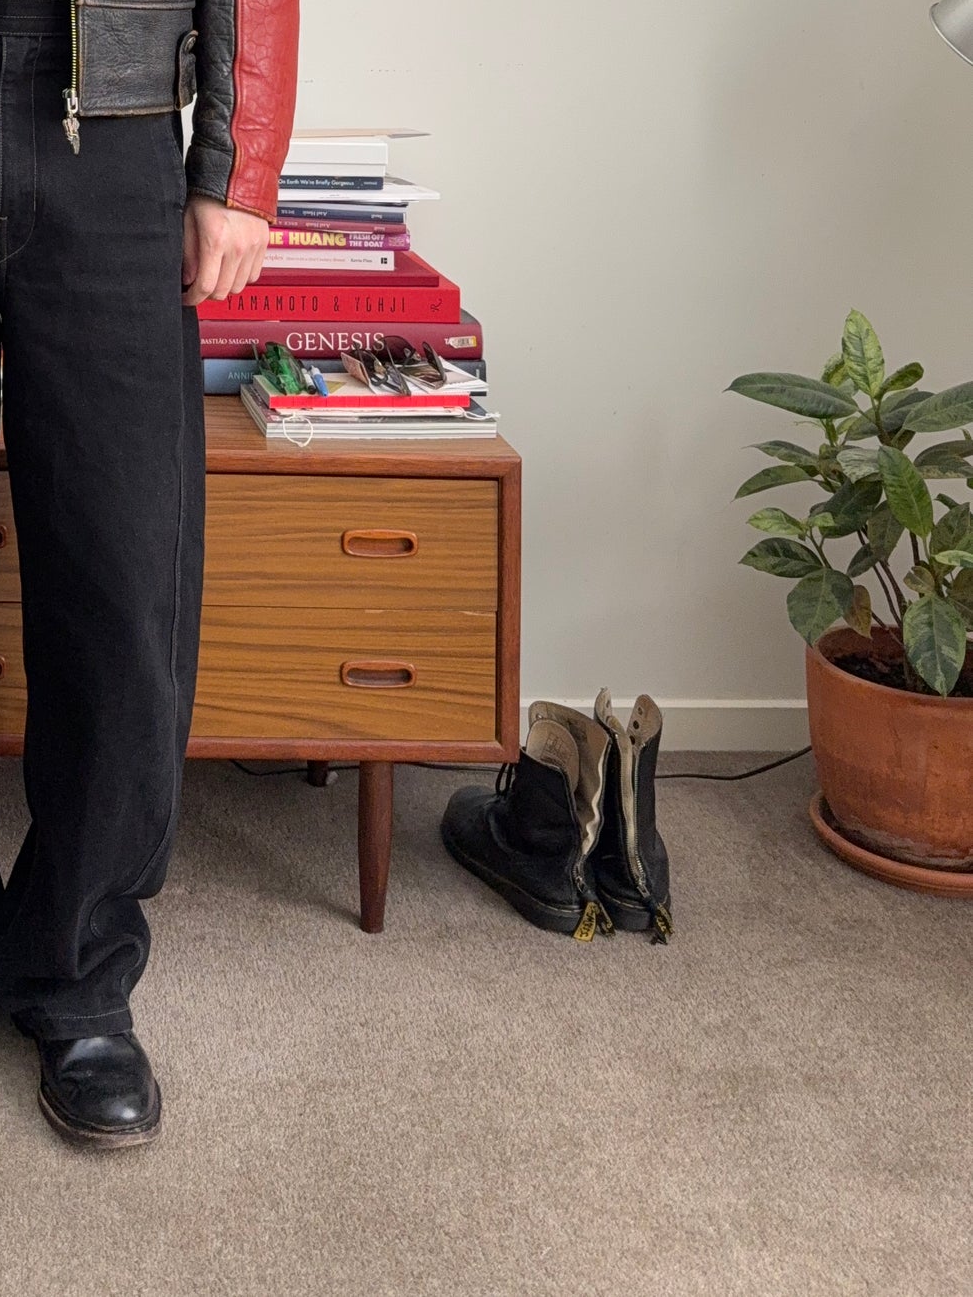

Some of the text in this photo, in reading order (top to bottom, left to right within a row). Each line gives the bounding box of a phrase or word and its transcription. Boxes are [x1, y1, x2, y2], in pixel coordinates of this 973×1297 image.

[289, 232, 346, 246] HUANG
[227, 295, 318, 312] YAMAMOTO
[333, 295, 340, 312] &
[286, 332, 385, 351] GENESIS
